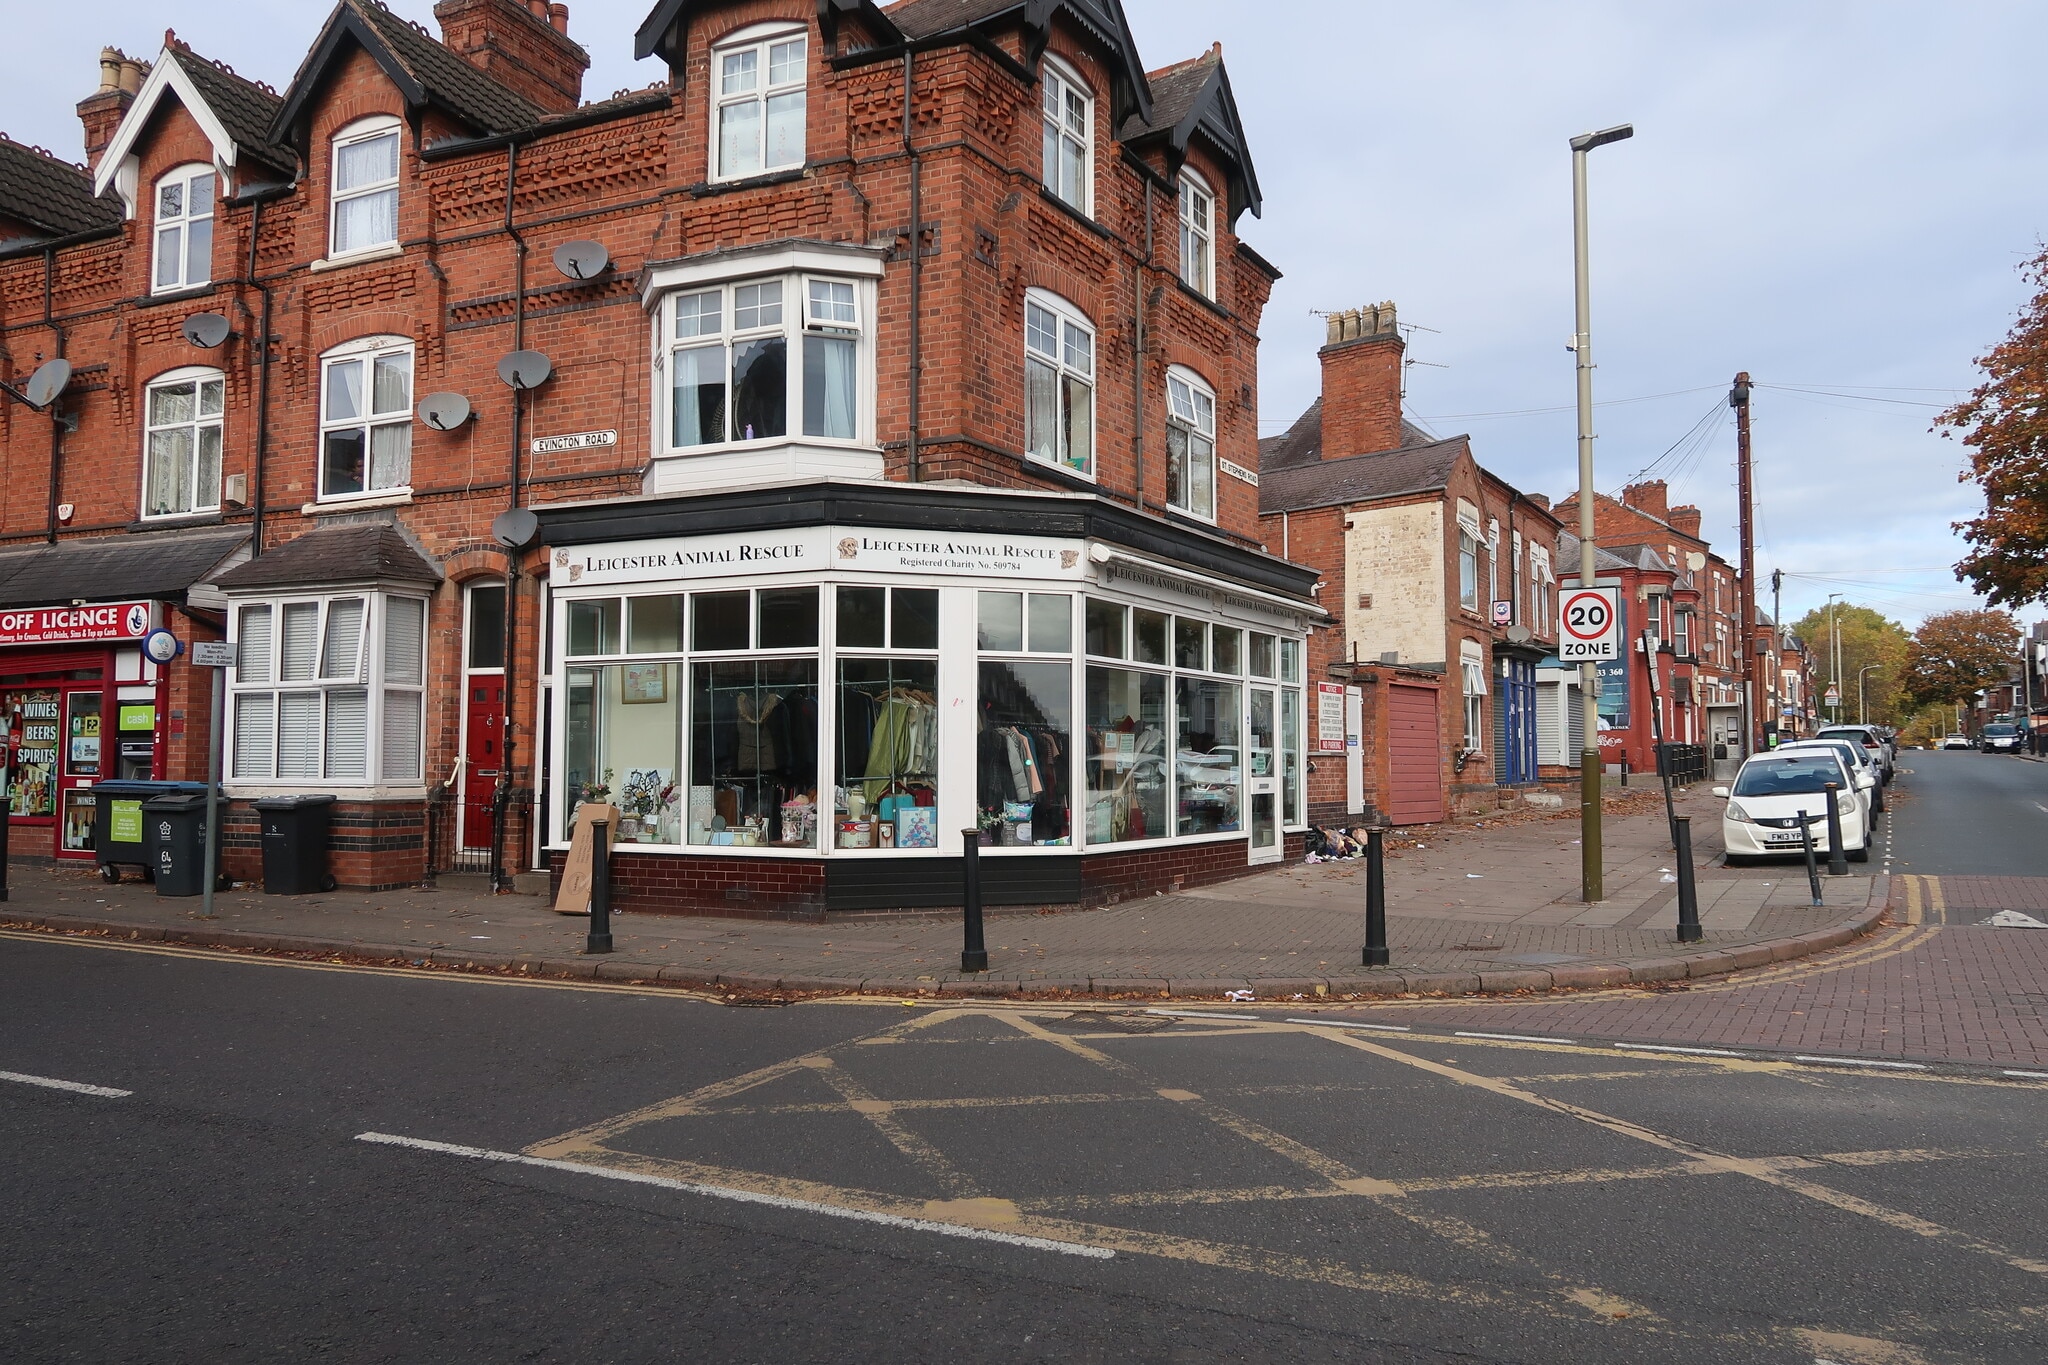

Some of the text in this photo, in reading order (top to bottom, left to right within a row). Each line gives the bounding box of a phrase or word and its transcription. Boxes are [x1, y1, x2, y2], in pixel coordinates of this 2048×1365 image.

[539, 433, 608, 451] EVINGTON ROAD
[862, 537, 1056, 560] LEICESTER ANIMAL RESCUE
[586, 543, 804, 572] LEICESTER ANIMAL RESCUE
[900, 556, 1021, 571] Registered Charity No. 509784
[1114, 565, 1210, 600] LEICESTER ANIMAL RESCUE
[1, 608, 118, 631] OFF LICENCE
[1570, 606, 1605, 626] 20
[1565, 643, 1611, 655] ZONE
[1608, 668, 1623, 676] 360
[24, 703, 57, 717] WINES
[127, 712, 149, 724] cash
[26, 726, 56, 740] BEERS
[17, 748, 55, 763] SPIRITS
[76, 796, 96, 805] WINES
[1771, 832, 1802, 841] FM13 YP
